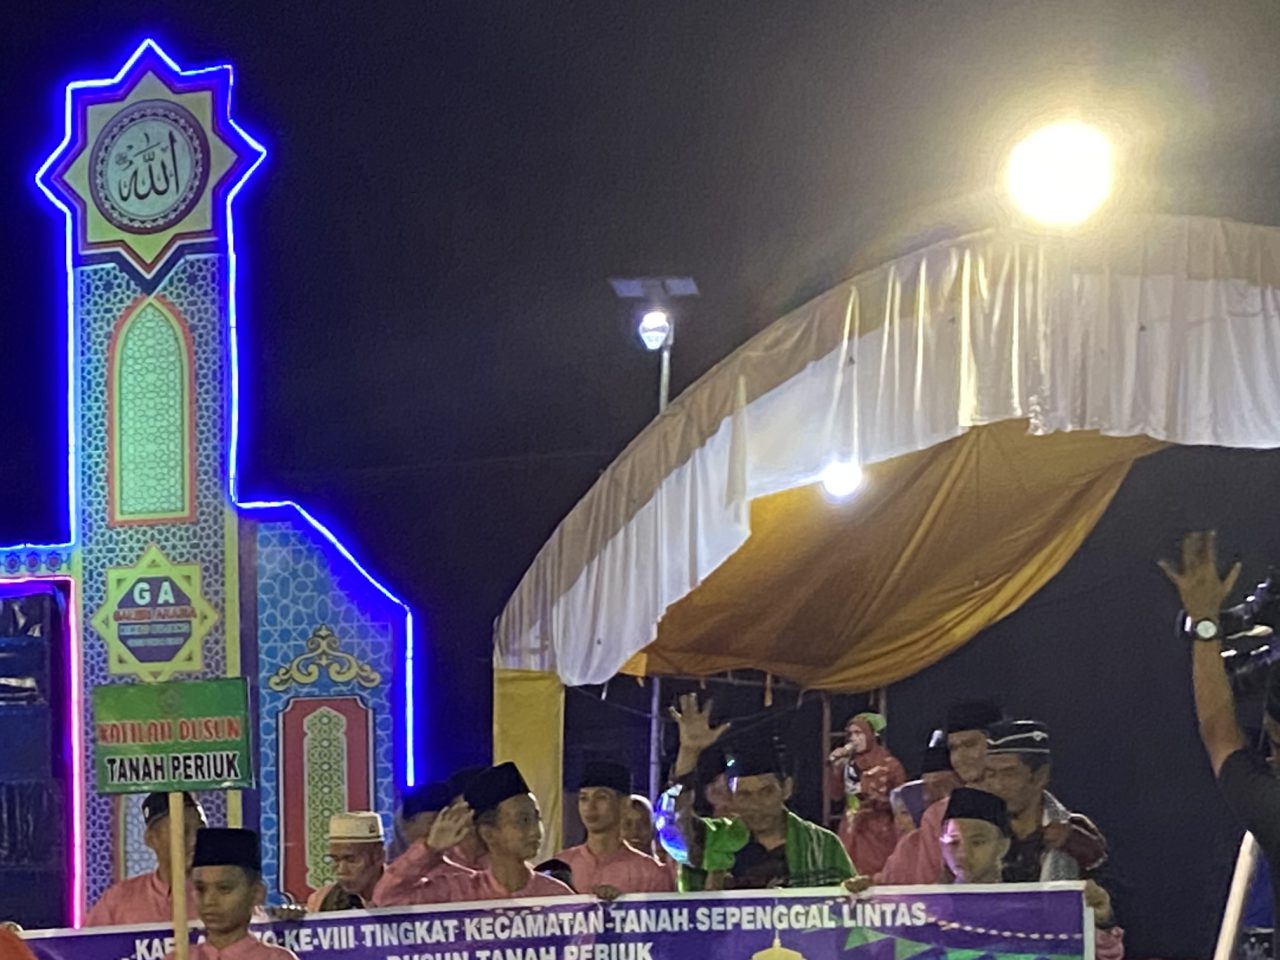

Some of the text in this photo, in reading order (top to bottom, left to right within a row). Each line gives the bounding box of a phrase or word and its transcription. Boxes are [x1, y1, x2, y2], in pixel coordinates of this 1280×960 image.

[104, 751, 241, 784] TANAH PERIUK
[361, 919, 457, 947] TINGKAT
[464, 909, 605, 942] KECAMATAN
[611, 906, 689, 934] TANAH
[695, 904, 837, 932] SEPENGGAL
[840, 901, 928, 929] LINTAS
